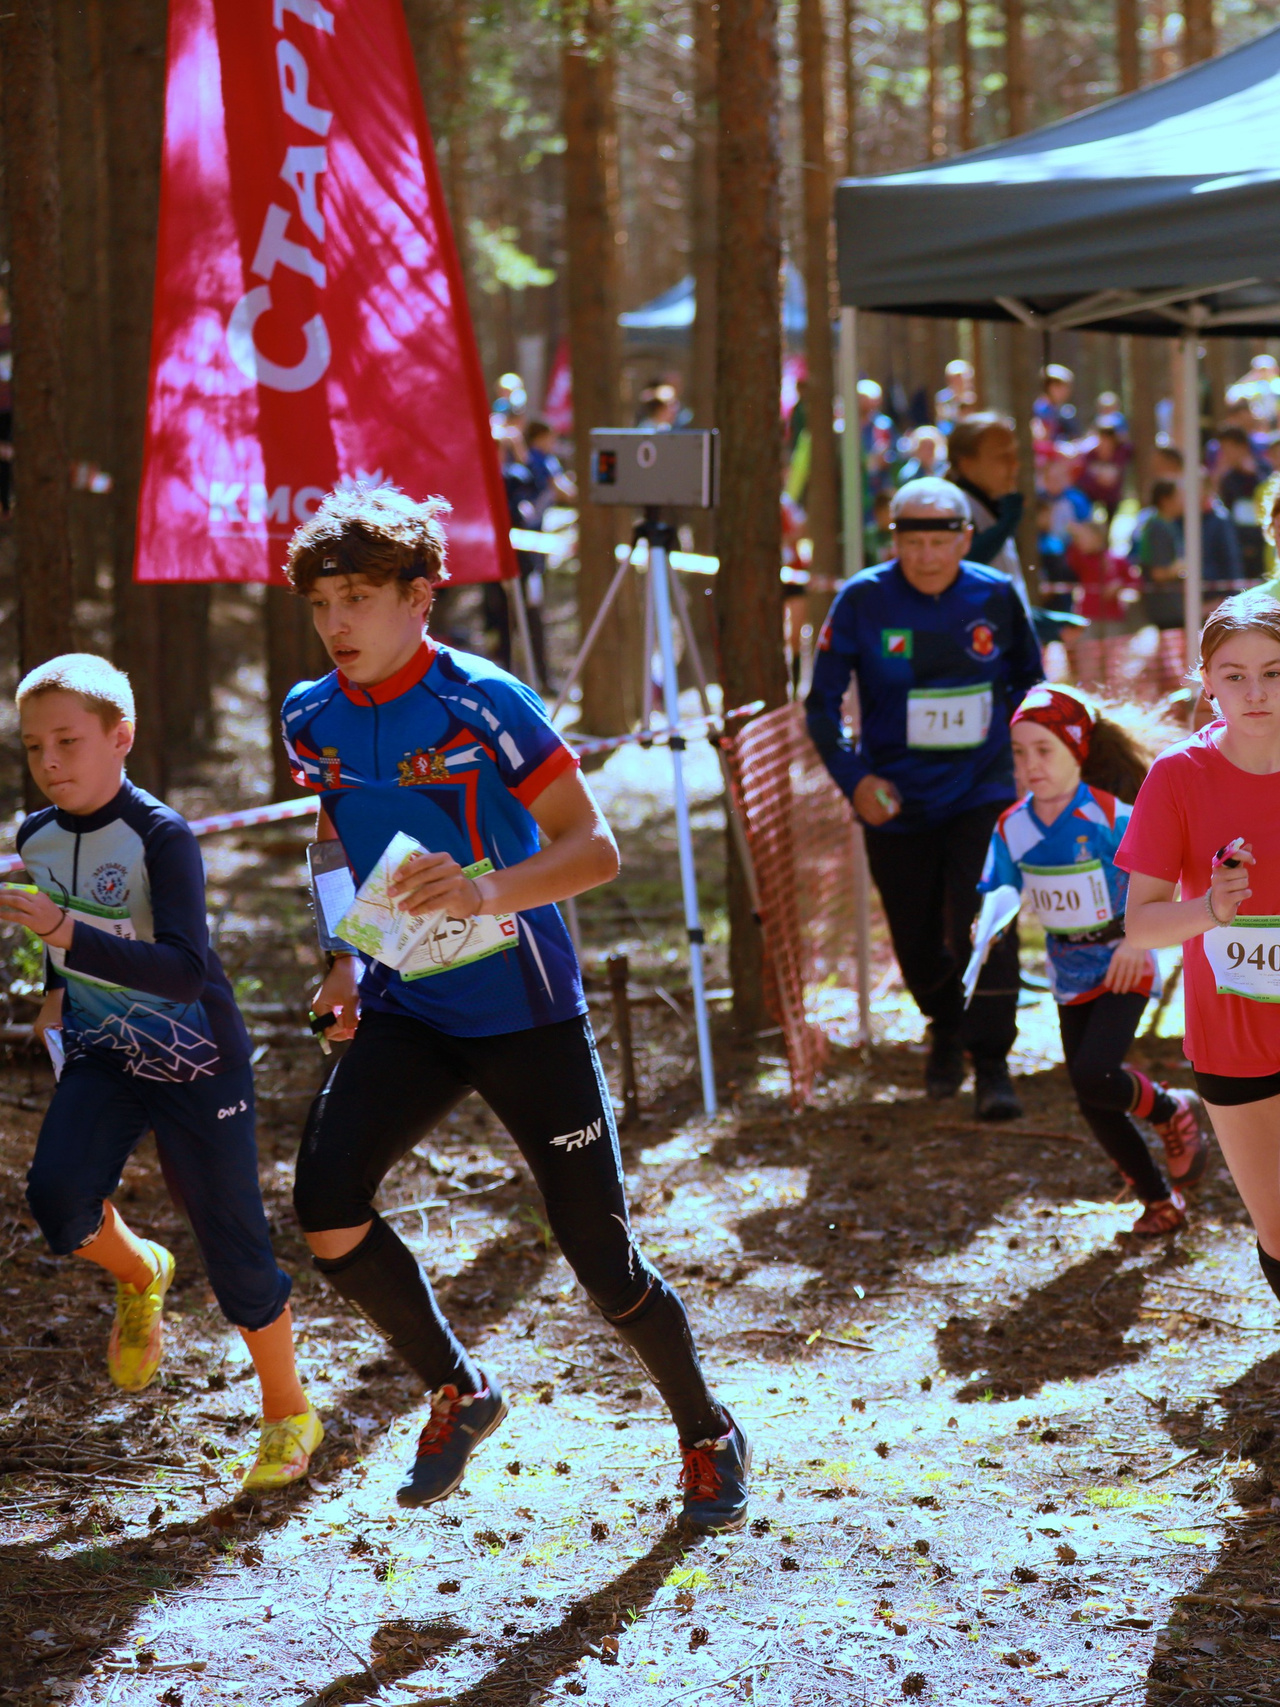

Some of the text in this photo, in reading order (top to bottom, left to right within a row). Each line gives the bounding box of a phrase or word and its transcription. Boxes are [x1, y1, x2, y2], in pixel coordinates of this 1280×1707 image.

[226, 0, 335, 392] СТАРТ
[925, 710, 964, 730] 714
[549, 1117, 602, 1152] RAY
